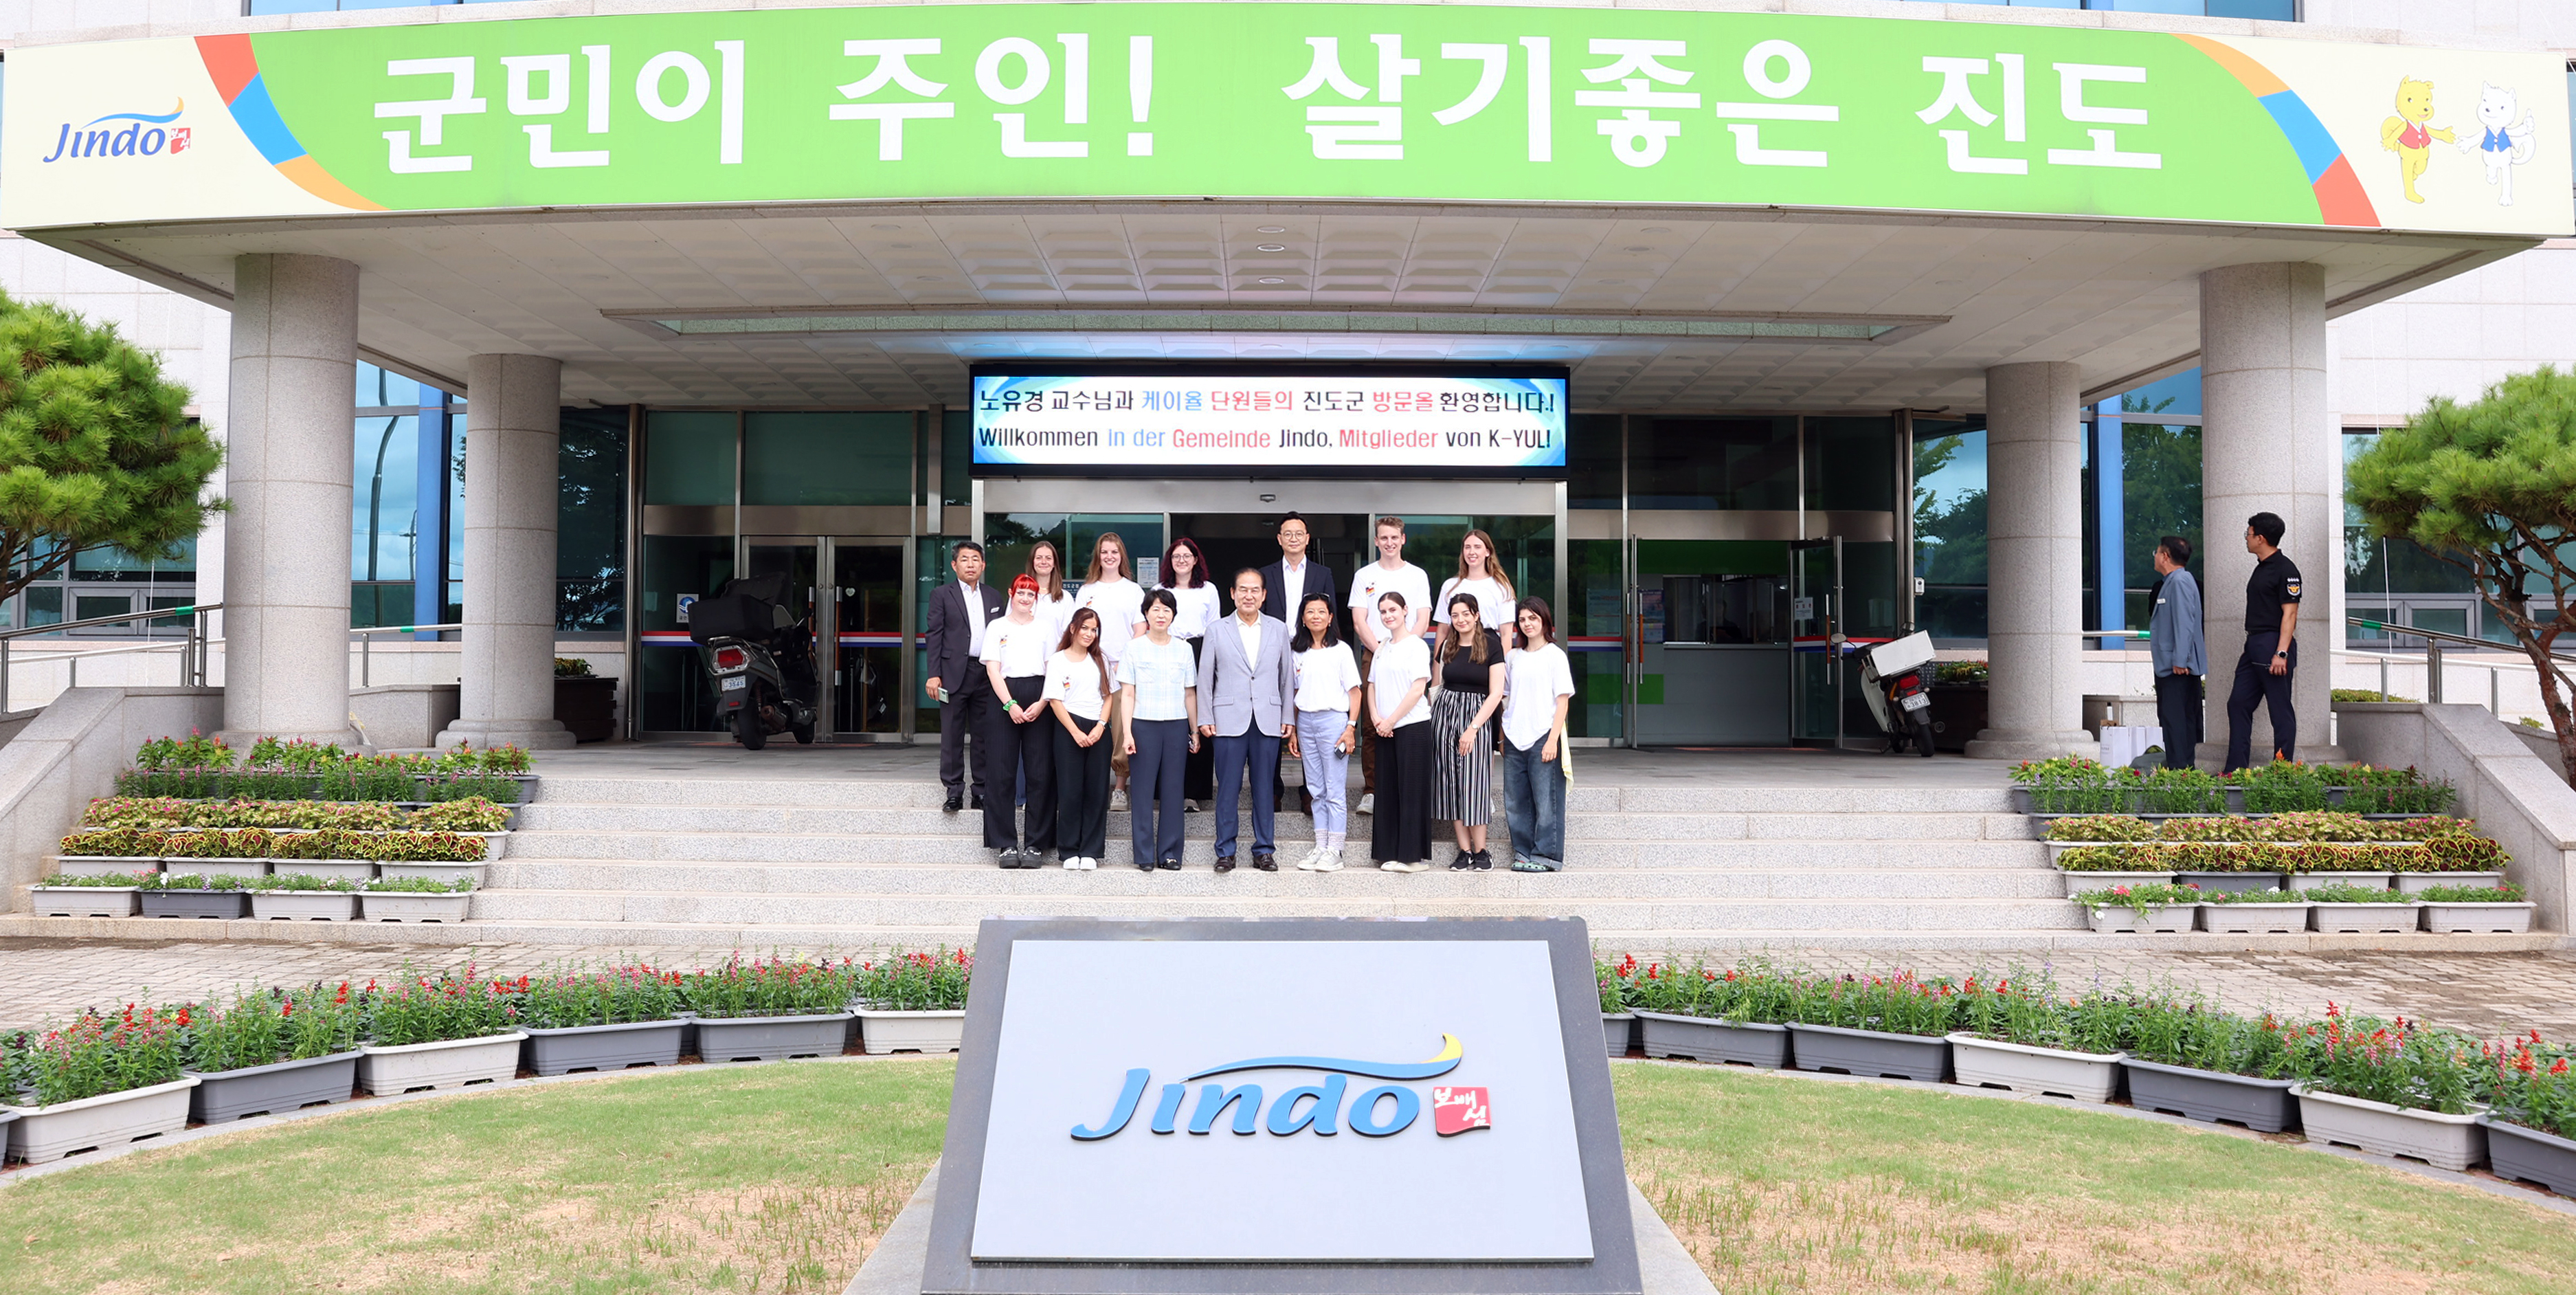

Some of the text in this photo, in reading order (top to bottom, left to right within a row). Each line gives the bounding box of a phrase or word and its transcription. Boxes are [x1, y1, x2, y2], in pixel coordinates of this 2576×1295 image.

[374, 32, 2162, 175] 군민이 주인! 살기좋은 진도
[43, 122, 166, 163] Jindo
[980, 390, 1043, 412] 노유경
[1051, 390, 1134, 411] 교수님과
[1141, 390, 1202, 412] 케이율
[1211, 390, 1293, 412] 단원들의
[1303, 390, 1364, 412] 진도군
[1374, 391, 1433, 413] 방문을
[978, 428, 1098, 447] Willkommen
[1108, 429, 1125, 447] in
[1133, 428, 1165, 447] der
[1172, 428, 1270, 448] Gemeinde
[1339, 429, 1439, 450] Mitglieder
[1446, 431, 1481, 447] von
[1489, 429, 1551, 449] K-YUL!
[1071, 1067, 1420, 1141] Jindo
